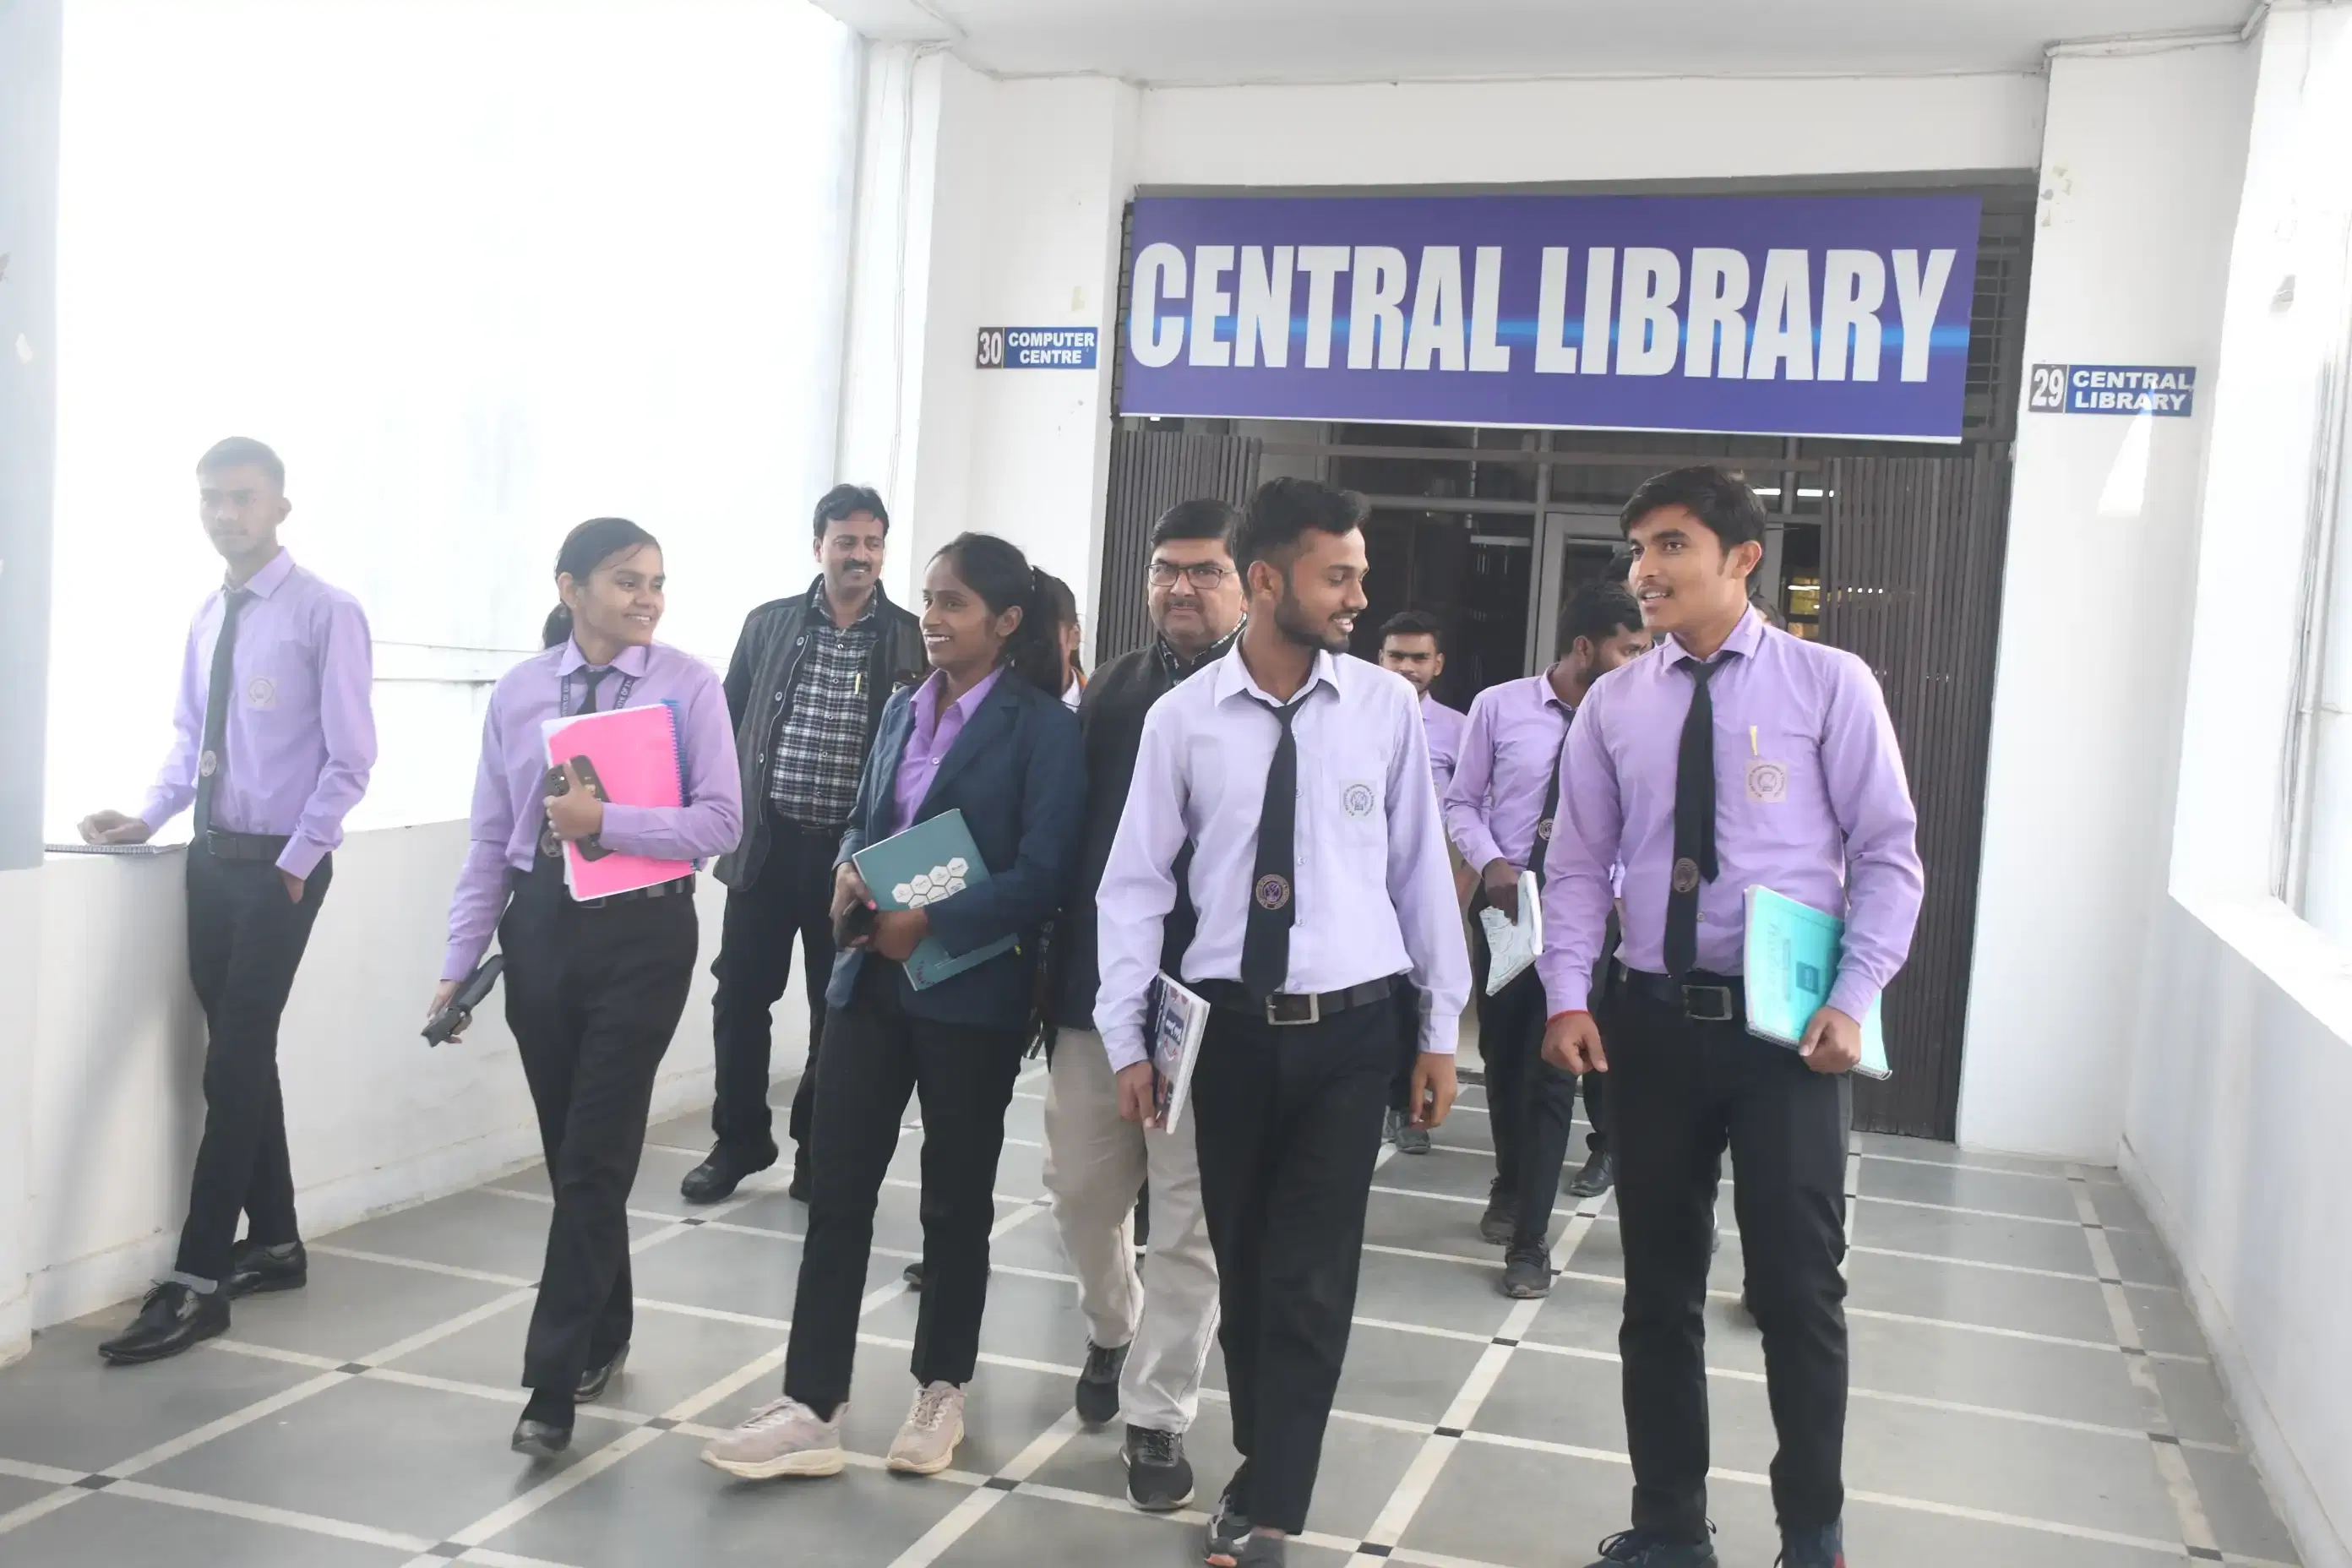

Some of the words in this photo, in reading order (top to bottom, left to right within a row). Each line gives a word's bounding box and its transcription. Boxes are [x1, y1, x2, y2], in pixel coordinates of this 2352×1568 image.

[1130, 242, 1510, 372] CENTRAL
[1535, 246, 1957, 383] LIBRARY
[978, 331, 1002, 364] 30
[1008, 332, 1095, 347] COMPUTER
[1020, 349, 1081, 364] CENTRE
[2031, 368, 2064, 407] 29
[2072, 370, 2194, 389] CENTRAL
[2075, 392, 2187, 411] LIBRARY
